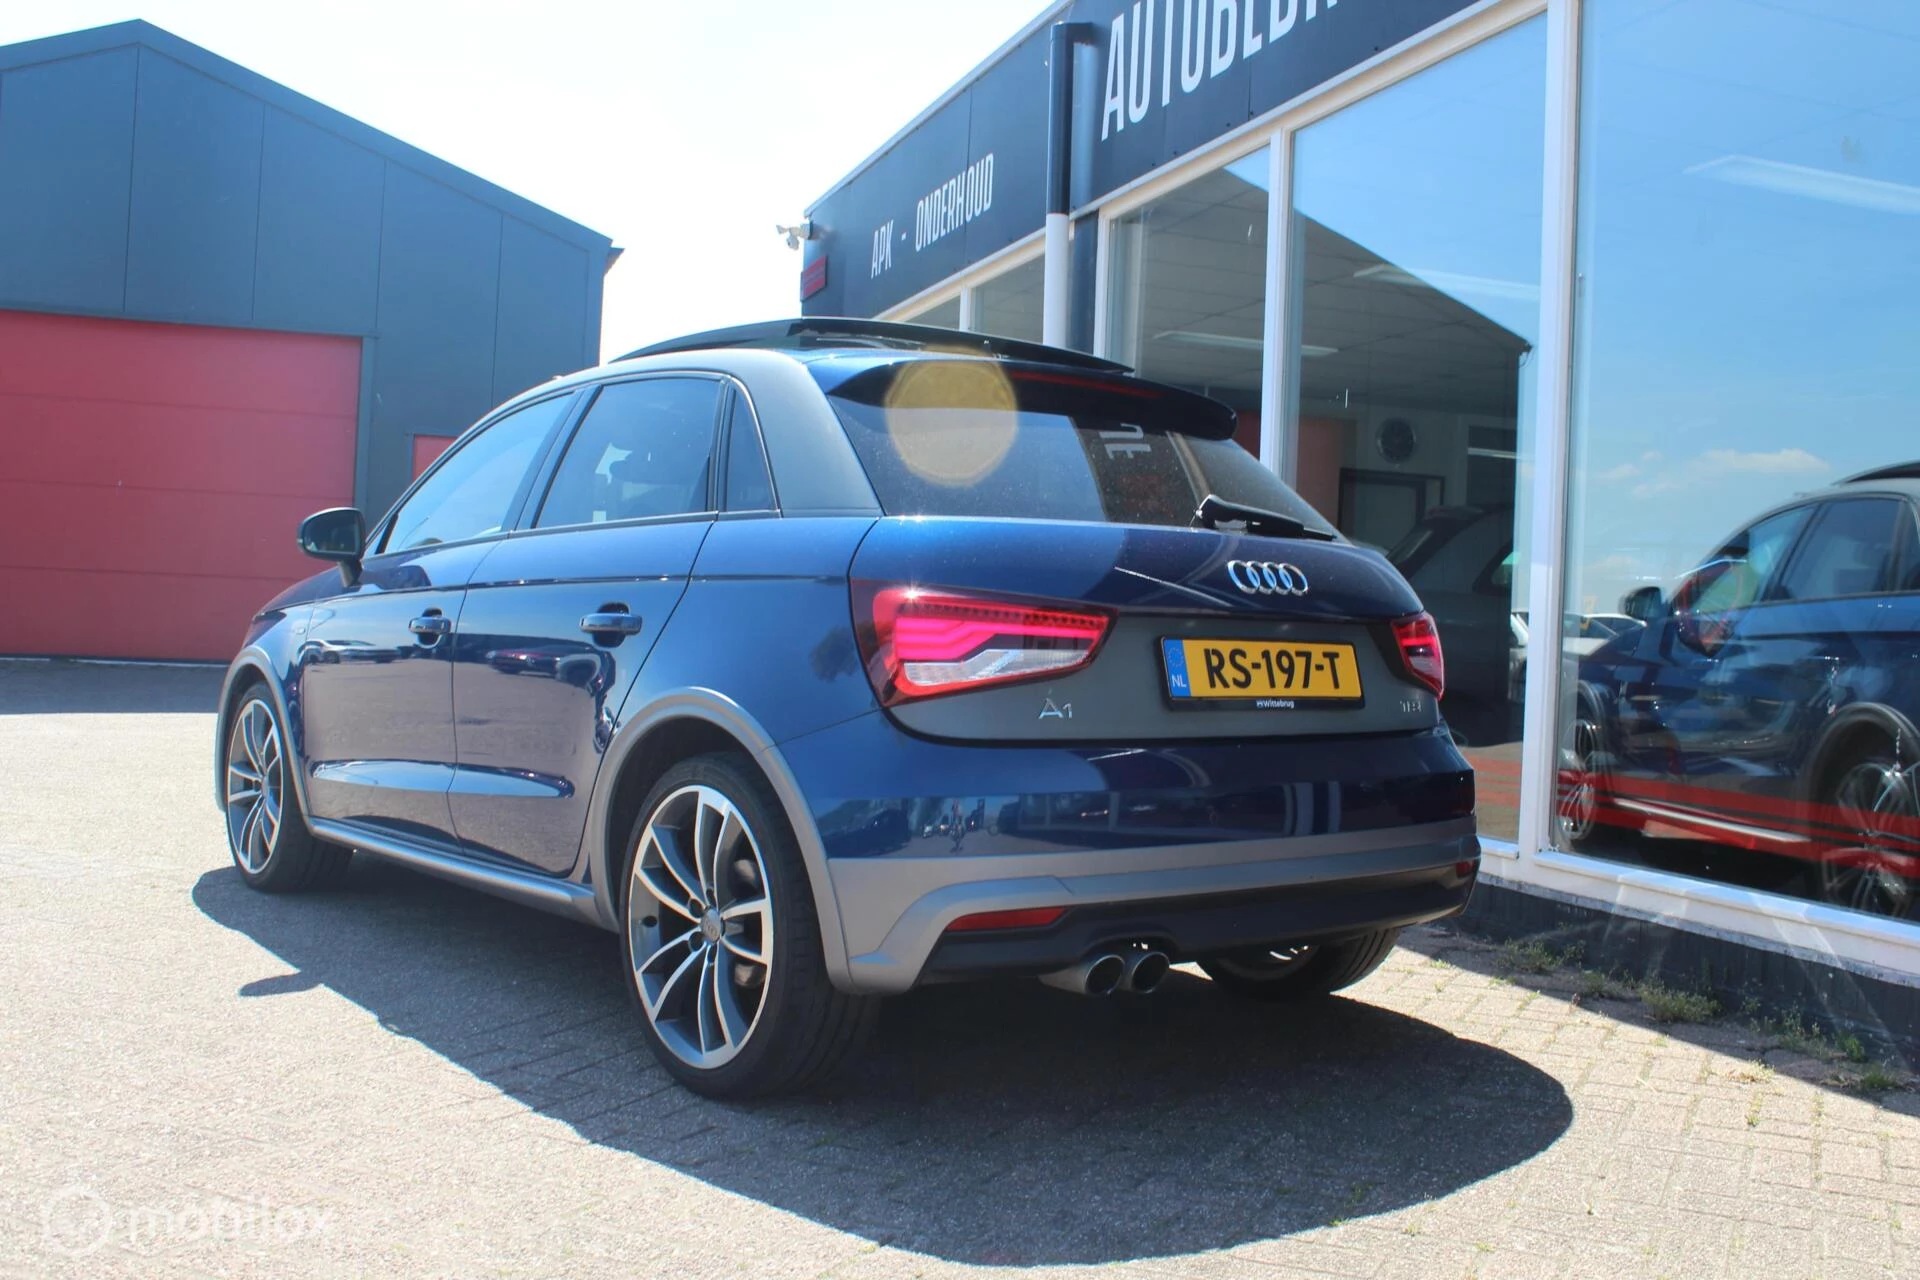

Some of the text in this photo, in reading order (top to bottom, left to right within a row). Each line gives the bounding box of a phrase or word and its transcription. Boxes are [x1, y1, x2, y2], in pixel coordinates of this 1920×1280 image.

[871, 219, 894, 279] APK
[915, 152, 994, 252] ONDERHOUD
[1171, 674, 1187, 688] NL
[1203, 648, 1341, 689] RS-197-T
[1038, 697, 1073, 720] A1
